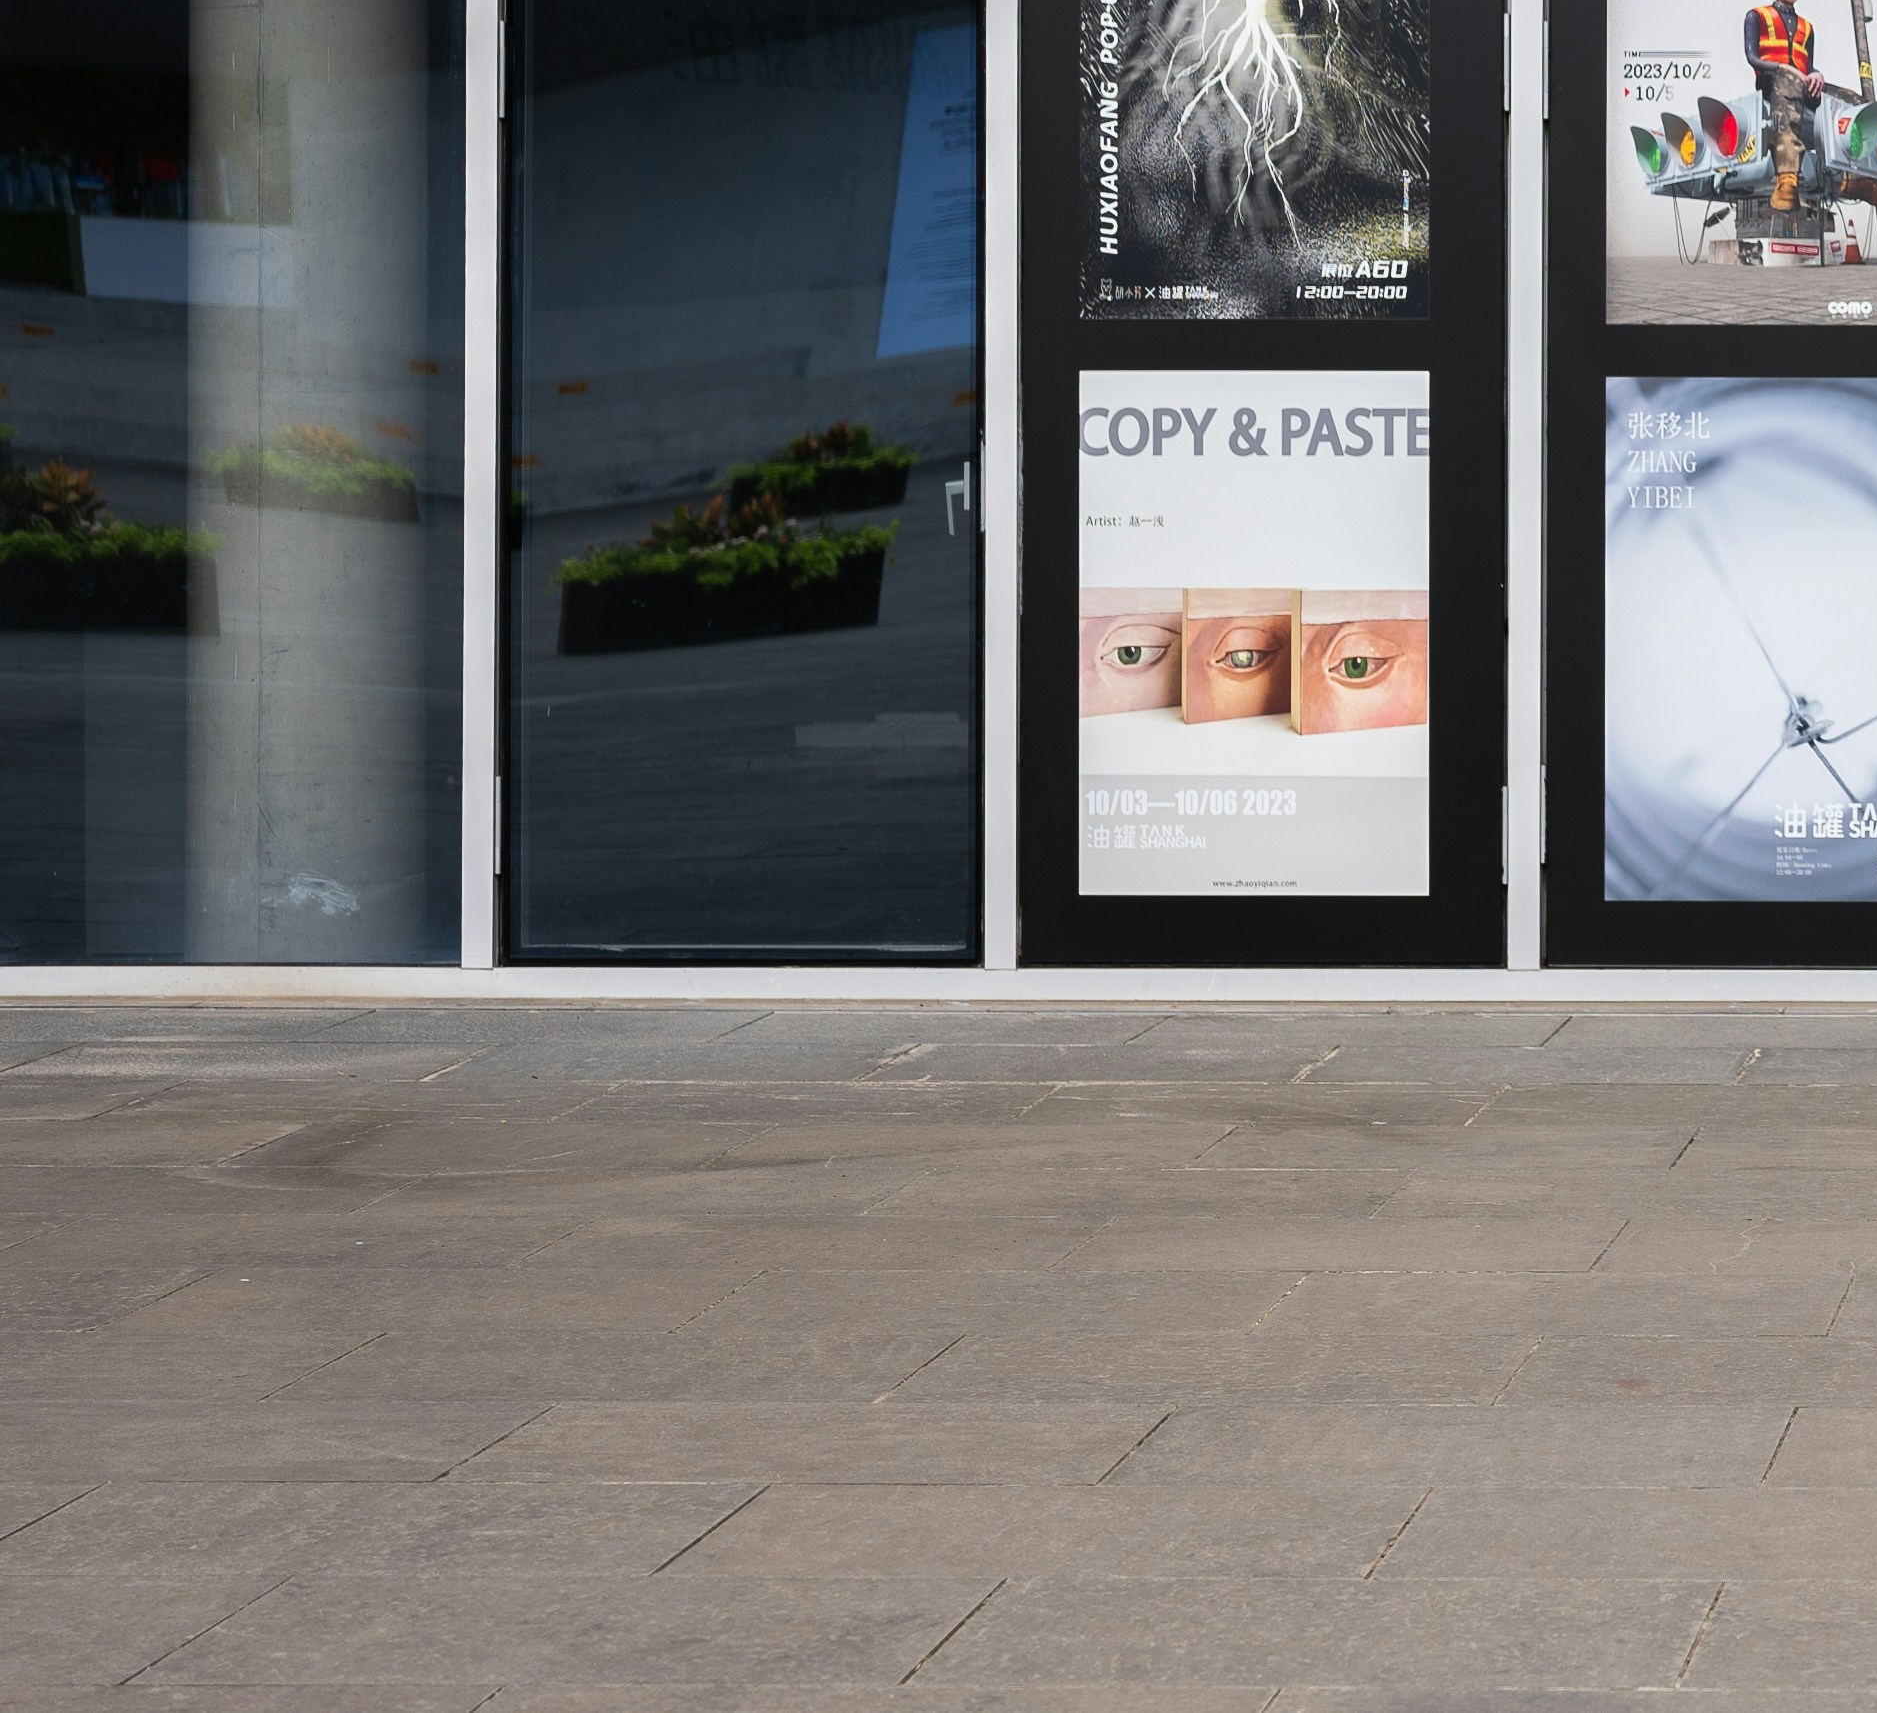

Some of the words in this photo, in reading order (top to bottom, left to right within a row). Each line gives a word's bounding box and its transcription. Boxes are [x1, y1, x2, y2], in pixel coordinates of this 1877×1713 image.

[1624, 62, 1711, 80] 2023/10/2
[1636, 84, 1674, 101] 10/5
[1099, 82, 1118, 256] HUXIAOFANG
[1355, 260, 1408, 278] A60
[1079, 407, 1217, 457] COPY
[1228, 407, 1268, 457] &
[1282, 407, 1429, 457] PASTE
[1627, 411, 1711, 441] 张移北
[1627, 450, 1698, 474] ZHANG
[1627, 486, 1696, 510] YIBEI
[1243, 789, 1297, 816] 2023
[1774, 802, 1845, 838] 油罐
[1087, 824, 1136, 848] 油罐
[1140, 824, 1184, 836] TANK
[1140, 836, 1206, 848] SHANGHAI
[1213, 879, 1297, 889] www.zhaoyiqian.com
